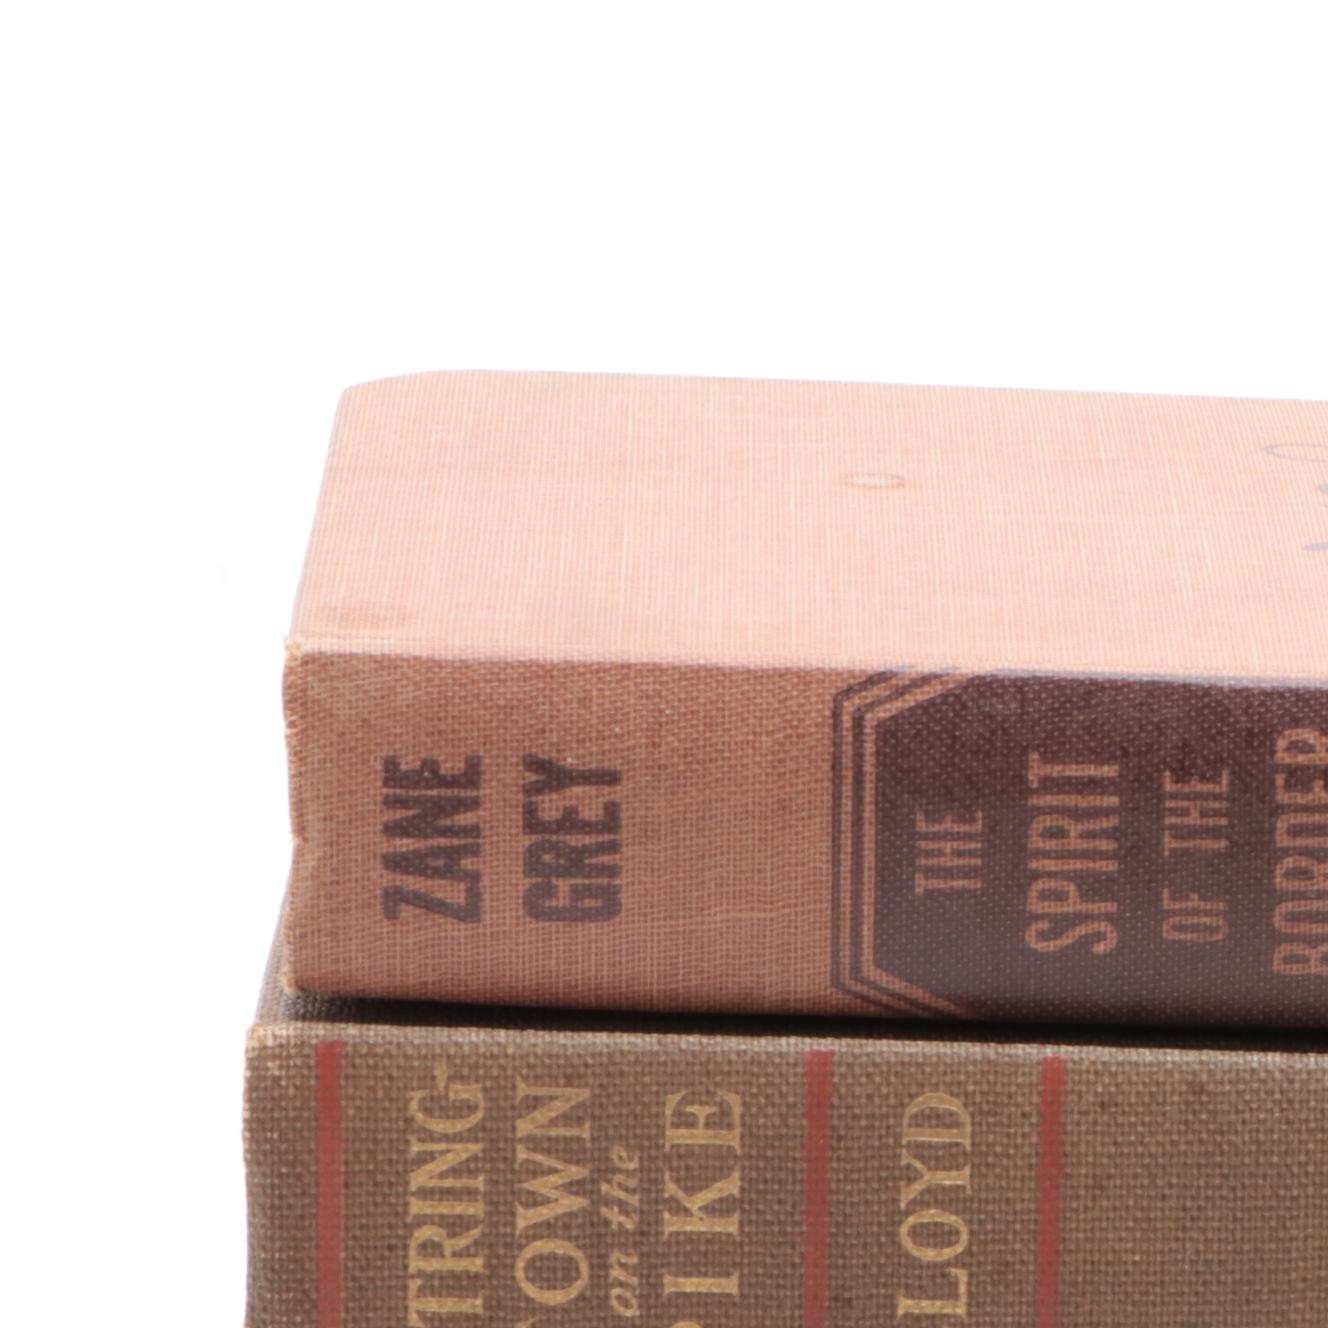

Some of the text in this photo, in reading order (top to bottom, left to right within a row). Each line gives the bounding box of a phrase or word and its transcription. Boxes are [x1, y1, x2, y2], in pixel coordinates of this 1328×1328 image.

[380, 754, 482, 924] ZANE
[521, 753, 623, 924] GREY
[914, 808, 984, 896] THE
[1024, 750, 1120, 956] SPIRIT
[1162, 767, 1231, 943] OF THE
[601, 1144, 640, 1317] on the
